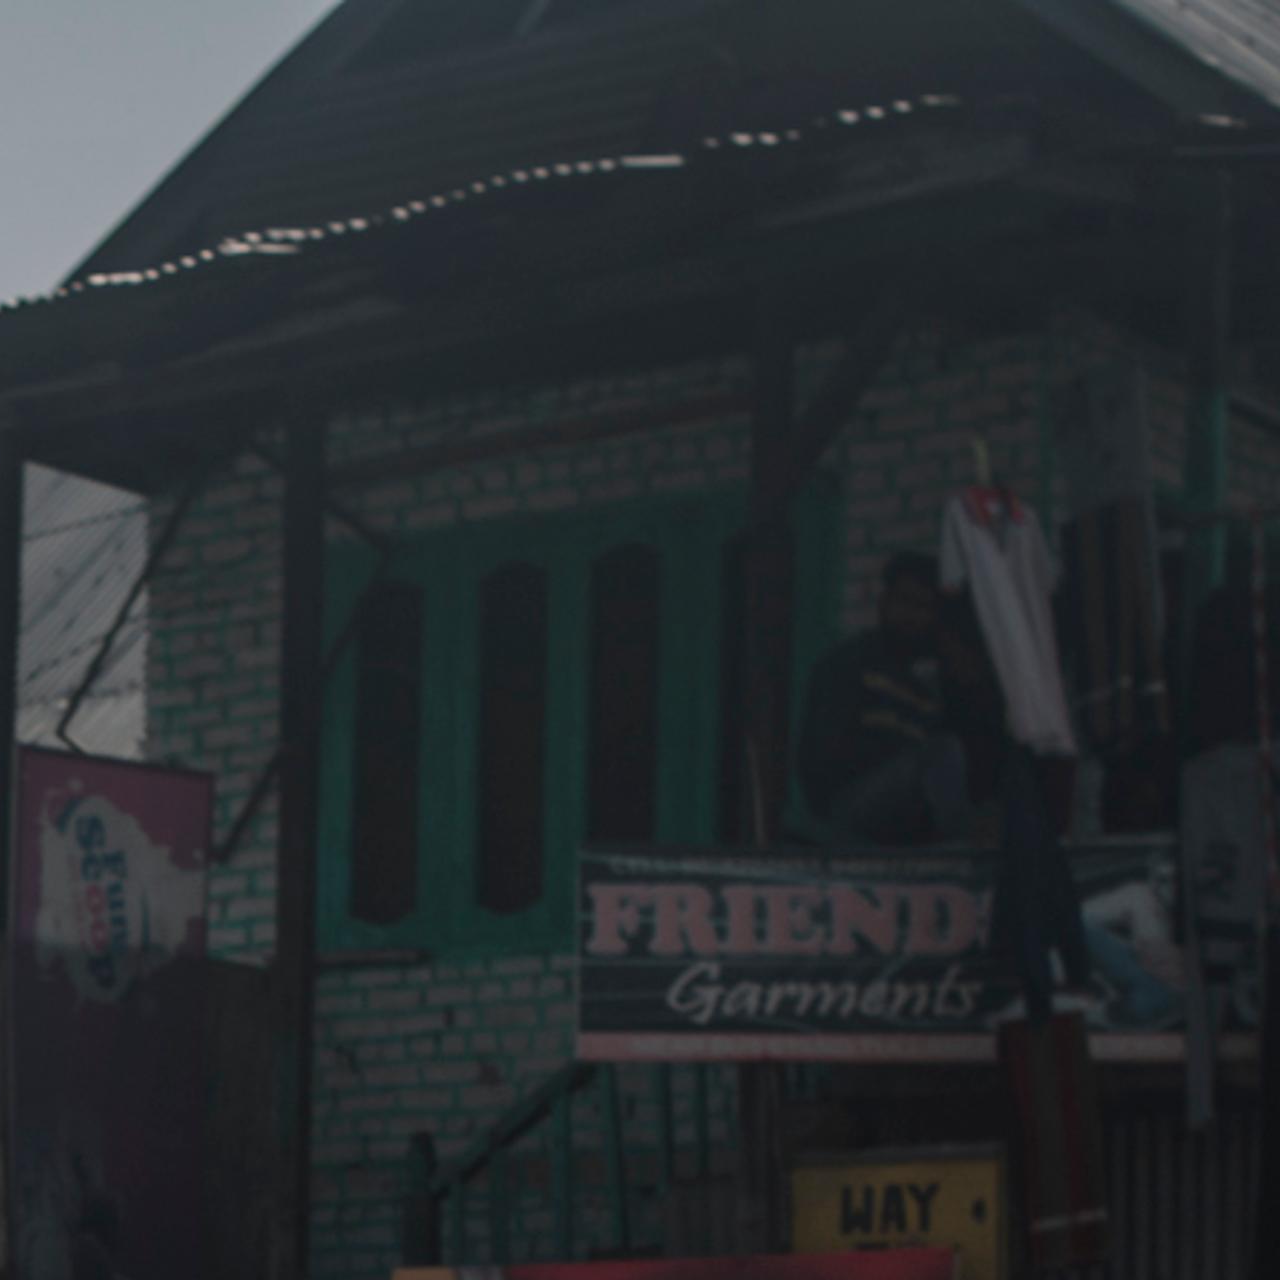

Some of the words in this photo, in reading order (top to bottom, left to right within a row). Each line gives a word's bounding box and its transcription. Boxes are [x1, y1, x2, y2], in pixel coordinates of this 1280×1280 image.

[586, 882, 994, 957] FRIEND
[664, 962, 983, 1025] Garments
[841, 1183, 939, 1234] WAY
